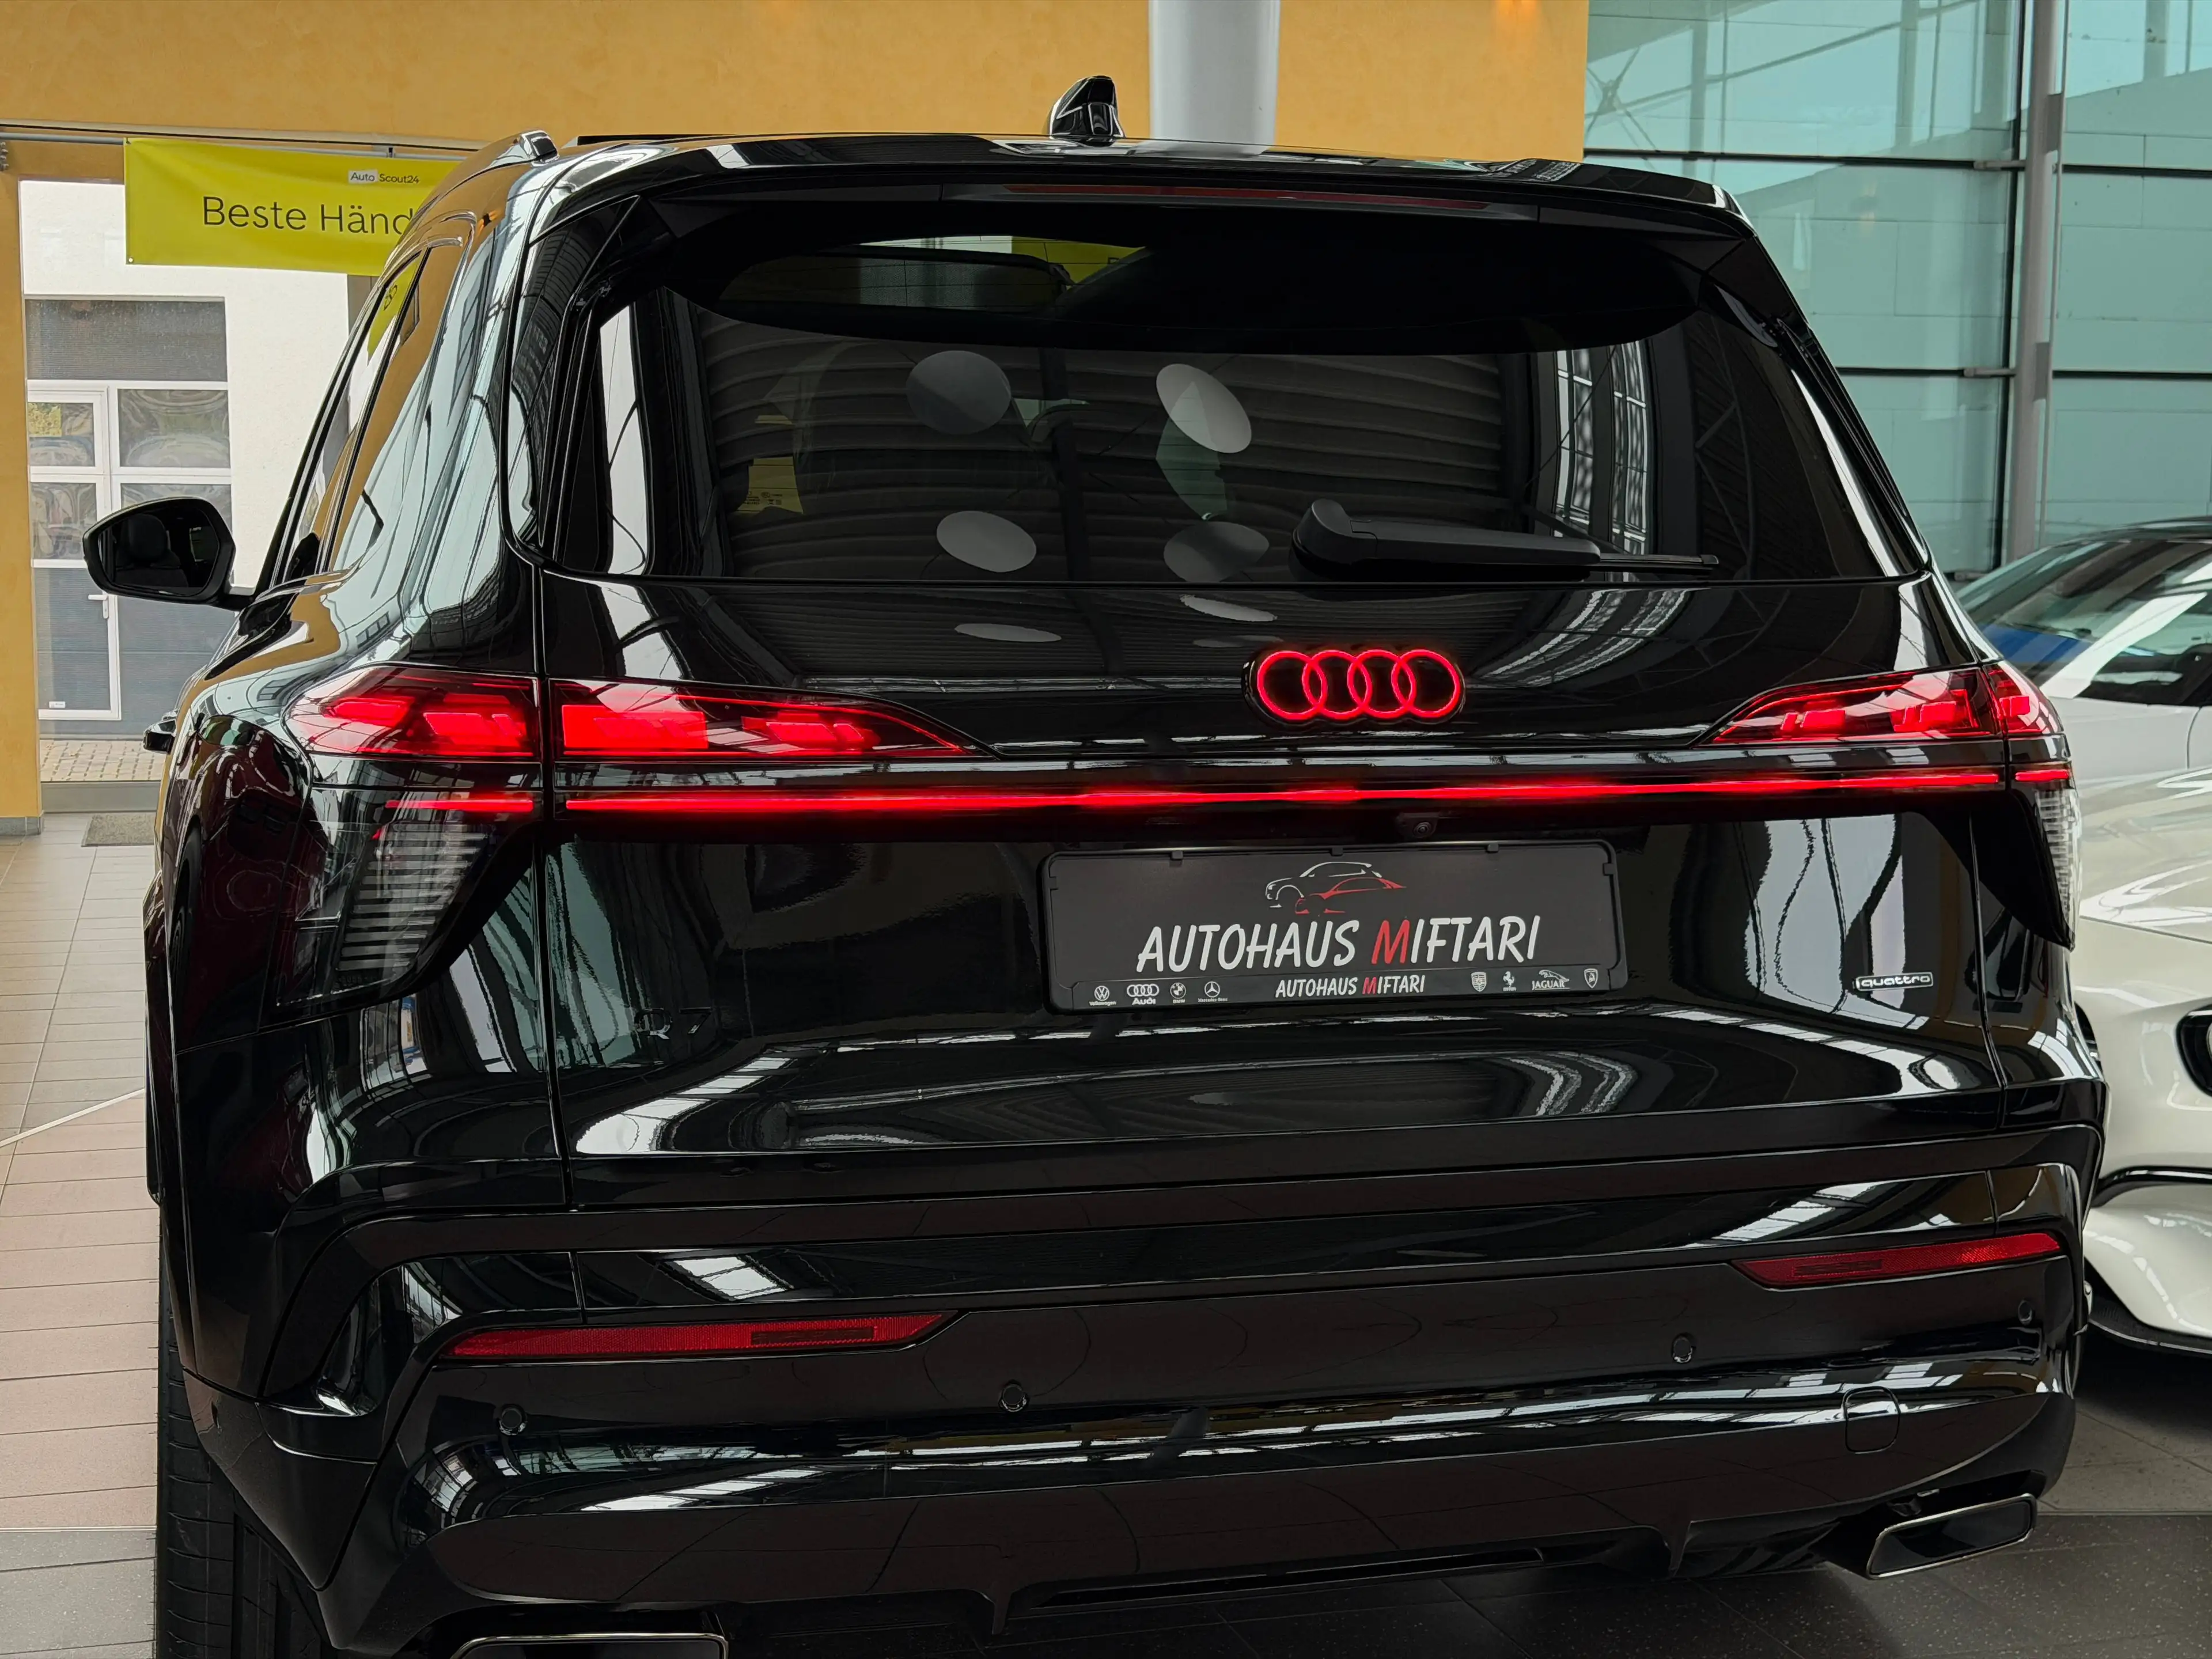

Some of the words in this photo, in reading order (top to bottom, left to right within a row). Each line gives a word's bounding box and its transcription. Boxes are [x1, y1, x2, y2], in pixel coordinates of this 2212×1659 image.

[350, 171, 376, 182] Auto
[379, 173, 420, 184] Scout24
[203, 195, 307, 230] Beste
[1136, 919, 1361, 972] AUTOHAUS
[1371, 915, 1541, 964] MIFTARI
[1275, 977, 1358, 998] AUTOHAUS
[1362, 975, 1426, 995] MIFTARI
[1532, 980, 1566, 990] JAGUAR
[1861, 975, 1930, 988] quattro
